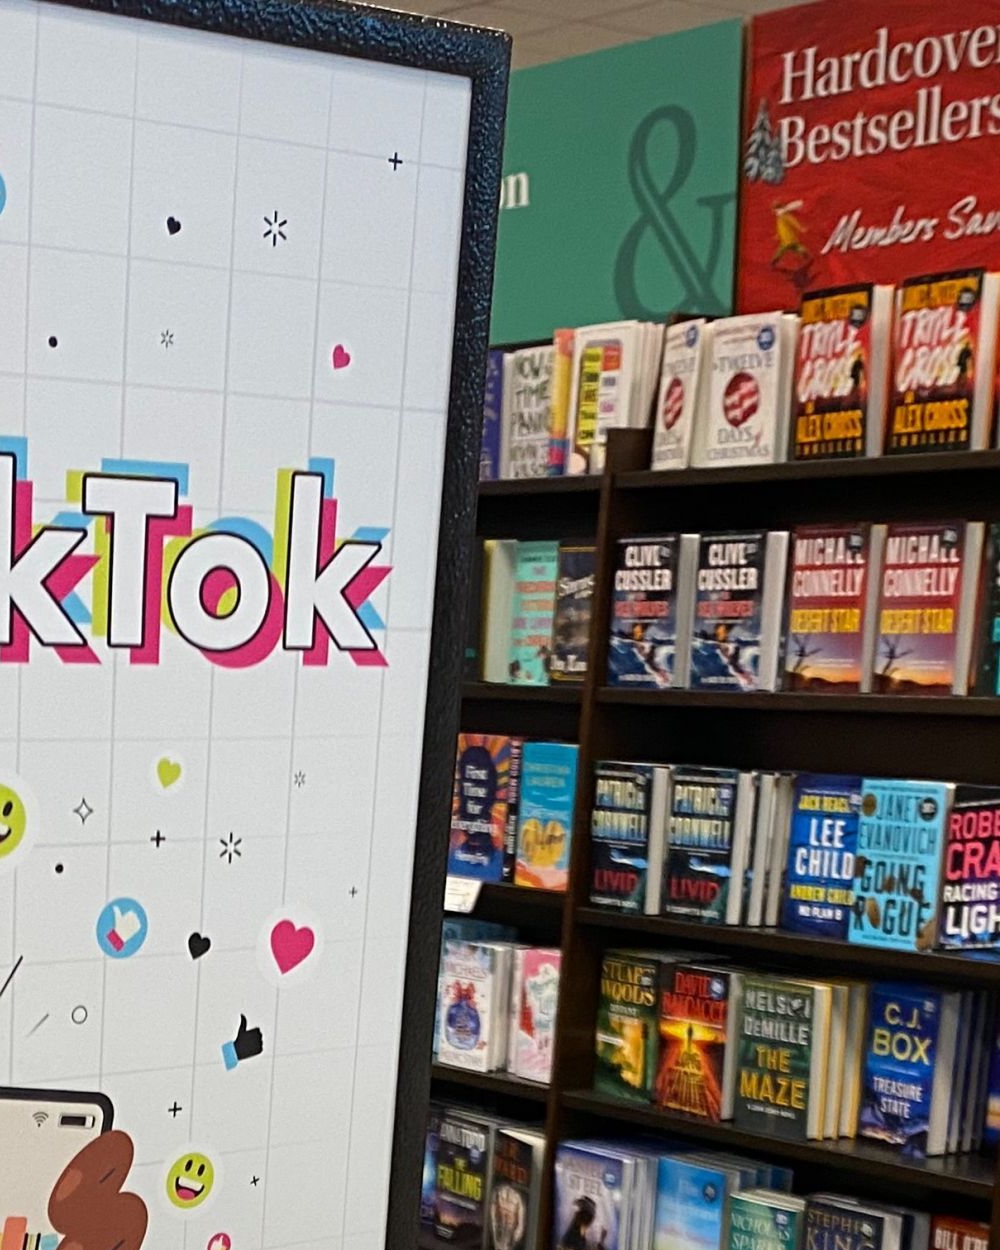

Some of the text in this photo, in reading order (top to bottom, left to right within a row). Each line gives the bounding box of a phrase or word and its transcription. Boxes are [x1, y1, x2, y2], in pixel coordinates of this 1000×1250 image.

[779, 26, 1000, 104] Hardcove
[778, 85, 1000, 168] Bestsellers
[820, 205, 940, 255] Members
[615, 569, 673, 591] CUSSLER
[698, 567, 759, 591] CUSSLER
[793, 568, 864, 597] CONNELLY
[884, 566, 960, 597] CONNELLY
[809, 817, 847, 849] LEE
[858, 822, 938, 855] EVANOVICH
[795, 847, 855, 881] CHILD
[860, 859, 927, 898] GOING
[943, 881, 1000, 903] RACING
[756, 1044, 792, 1074] THE
[872, 1027, 933, 1067] BOX
[740, 1069, 806, 1111] MAZE
[873, 1076, 924, 1103] TREASURE
[880, 1097, 911, 1119] STATE
[807, 1207, 864, 1235] STEPH
